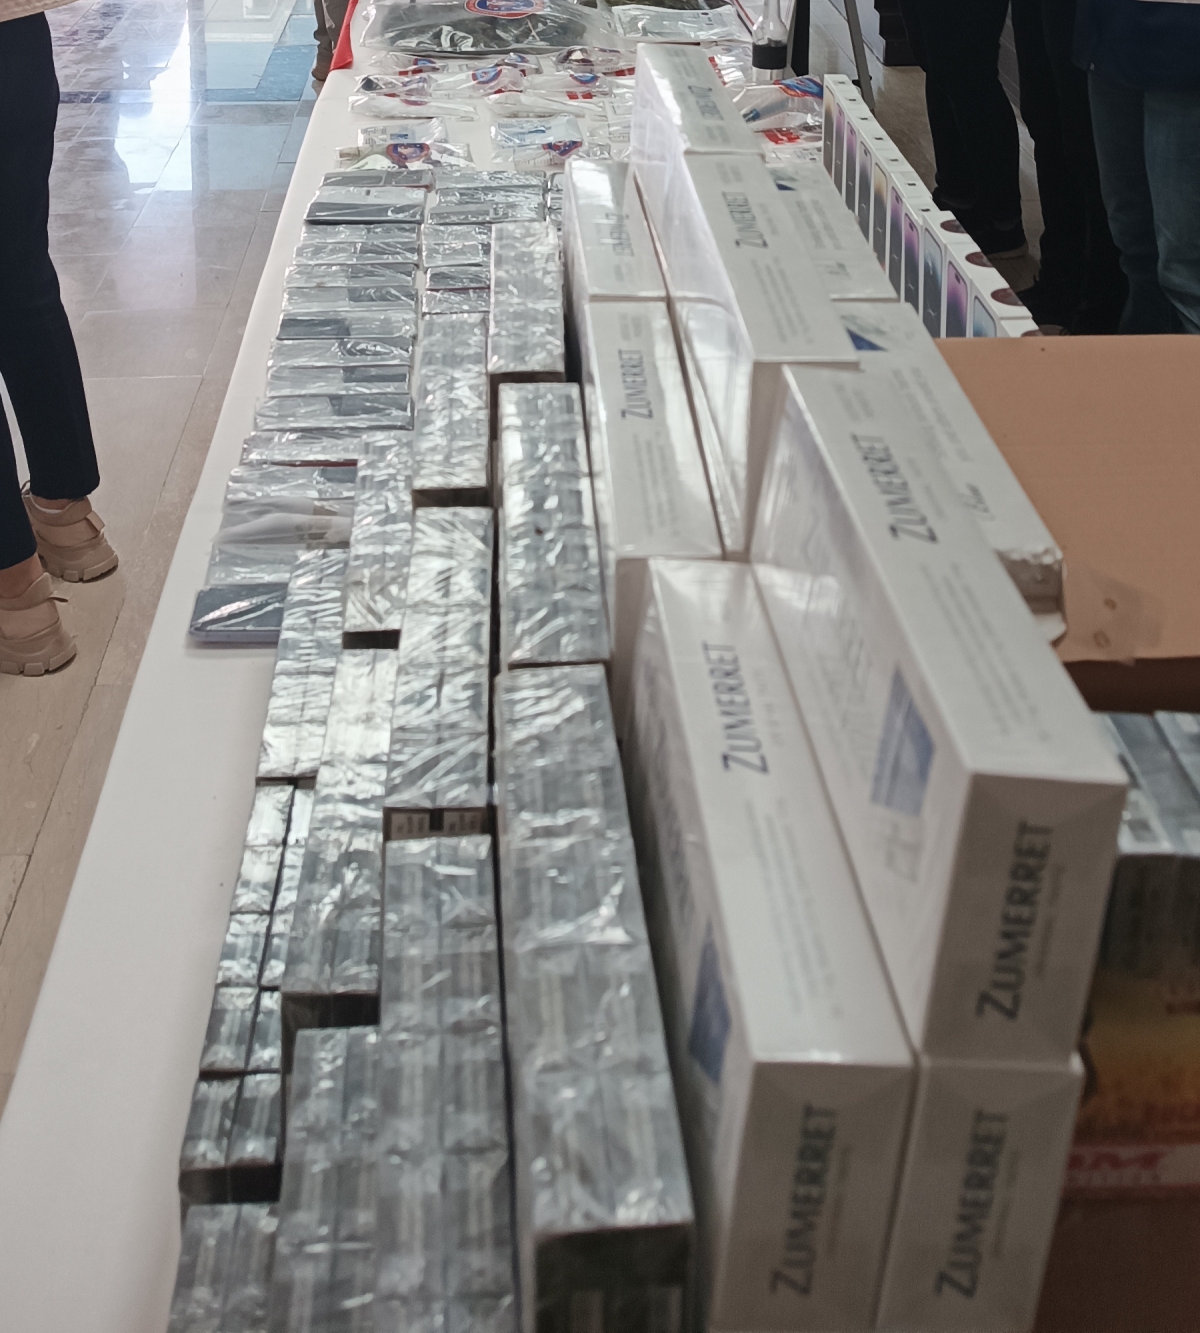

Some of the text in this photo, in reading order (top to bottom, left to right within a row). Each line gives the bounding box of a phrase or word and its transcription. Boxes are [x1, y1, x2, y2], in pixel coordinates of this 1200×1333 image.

[618, 349, 655, 420] ZUMERRET
[850, 431, 939, 545] ZUMERRET
[702, 640, 770, 776] ZUMERRET
[975, 821, 1053, 1022] ZUMERRET
[769, 1104, 840, 1297] ZUMERRET
[934, 1109, 1012, 1298] ZUMERRET
